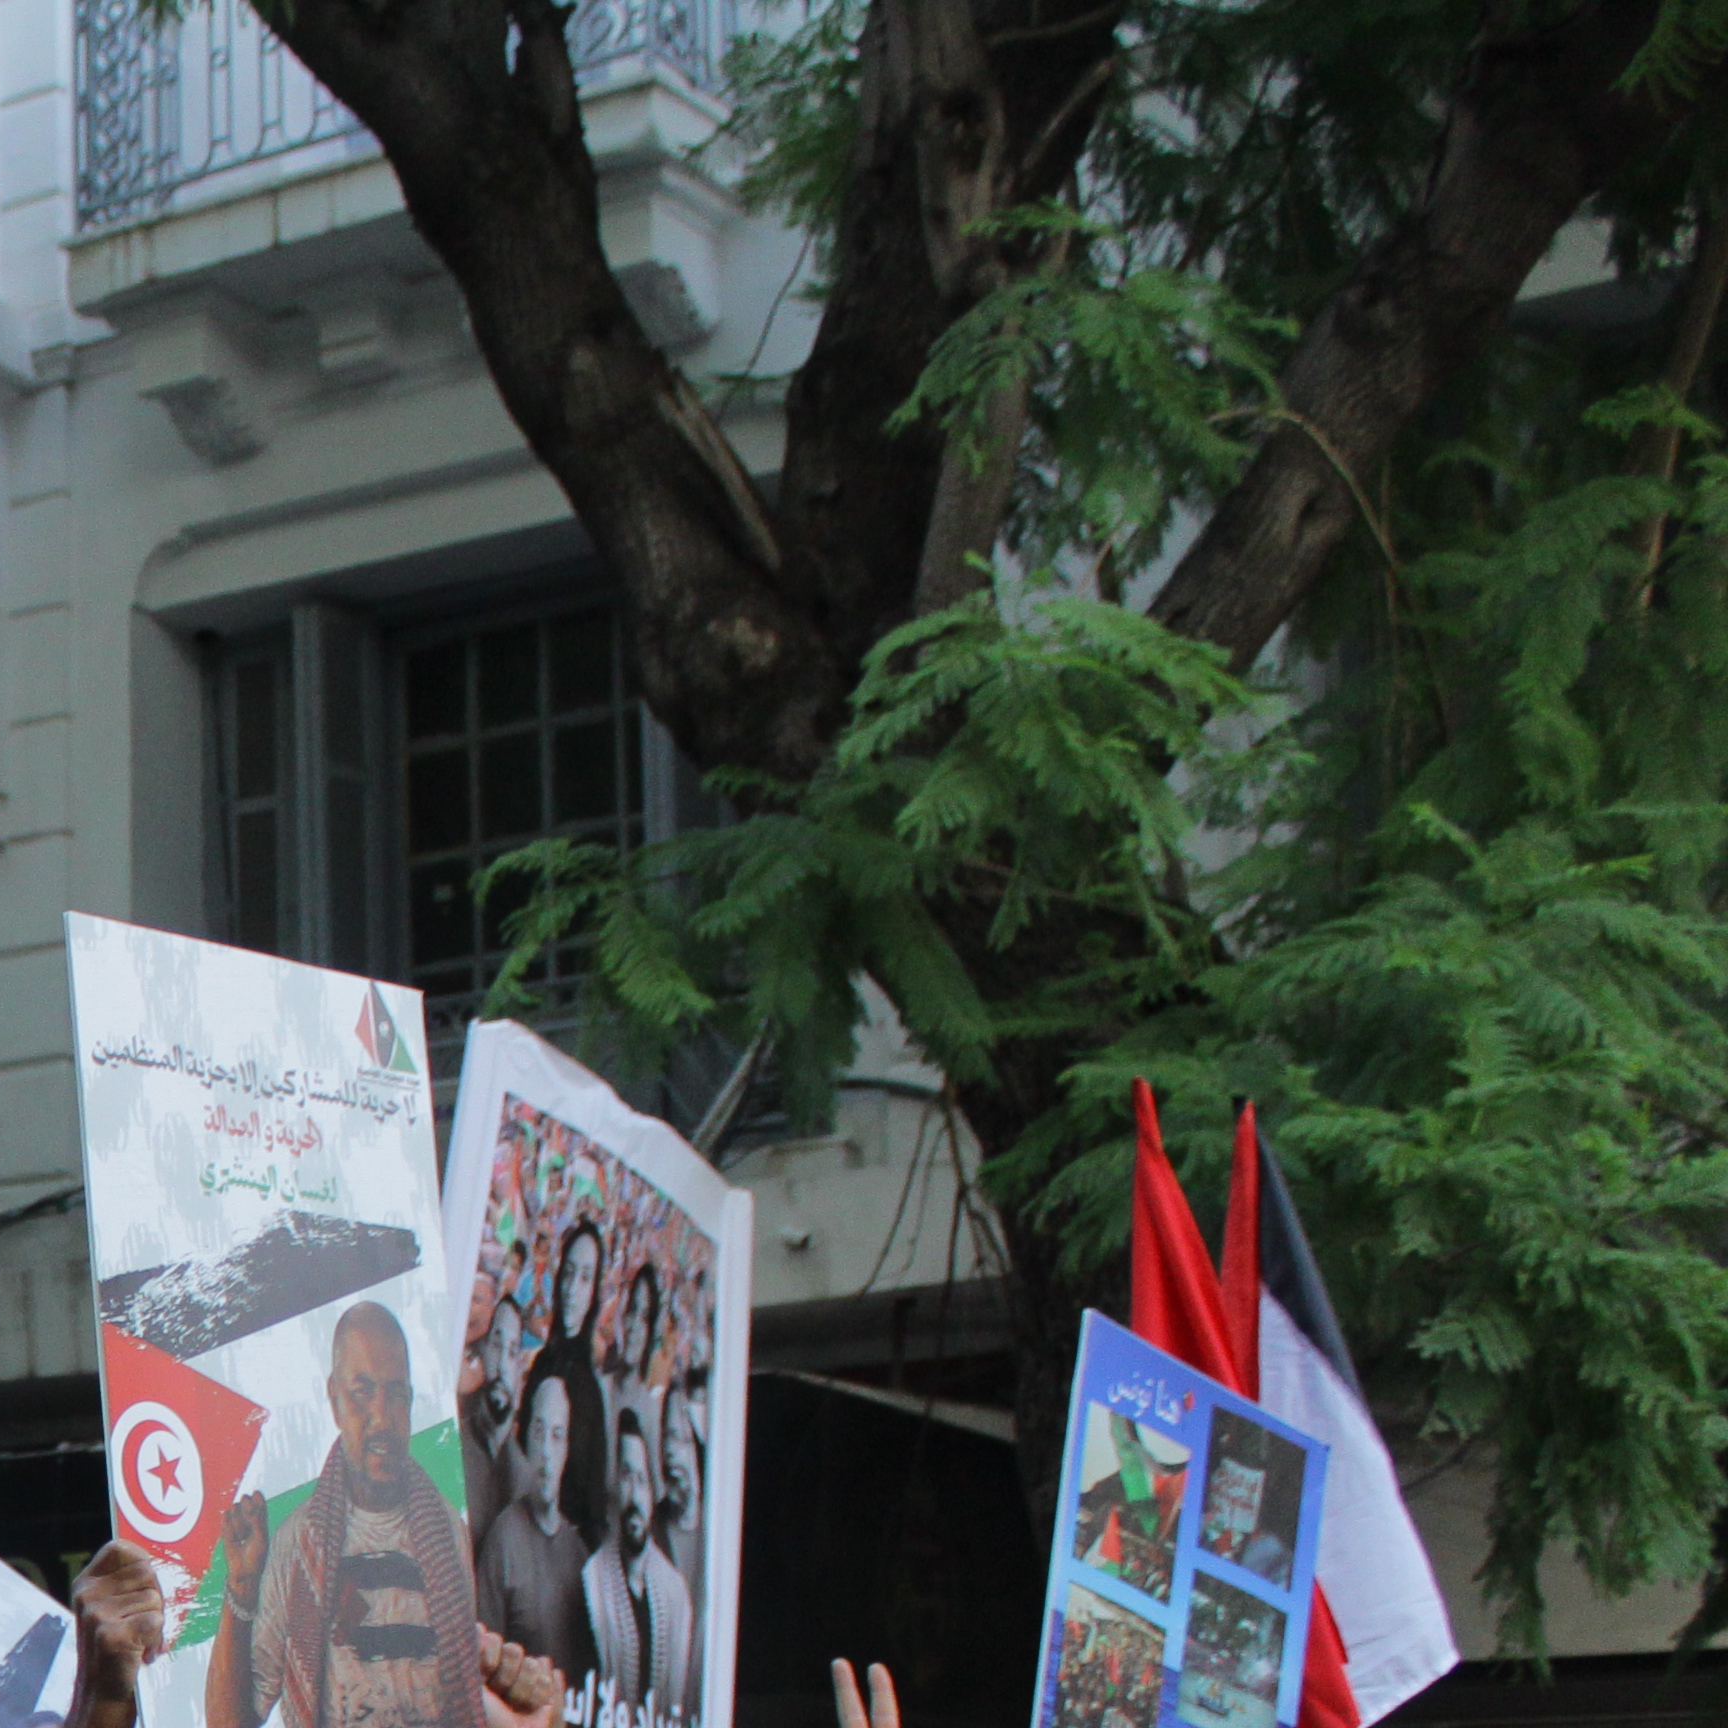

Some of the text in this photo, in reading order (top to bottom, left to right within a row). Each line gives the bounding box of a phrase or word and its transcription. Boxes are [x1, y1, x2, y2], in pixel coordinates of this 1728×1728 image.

[92, 1036, 184, 1073] المنظمين
[261, 1069, 358, 1108] للمشاركين
[361, 1086, 400, 1125] حرية
[203, 1103, 324, 1157] الحرية و العدالة
